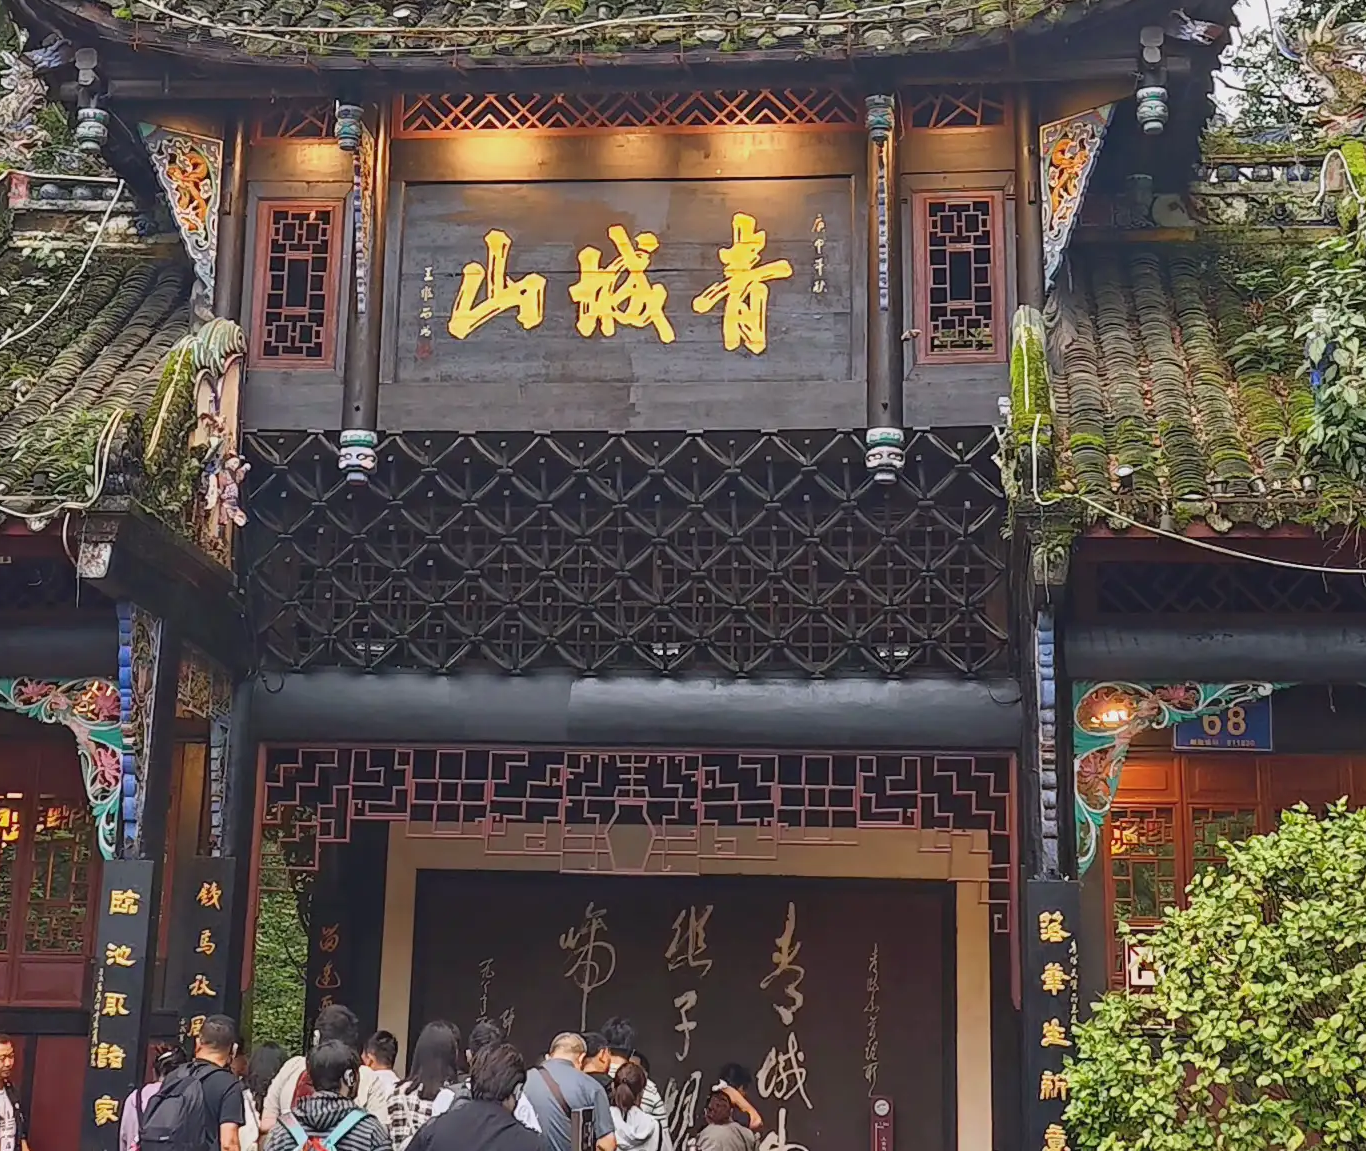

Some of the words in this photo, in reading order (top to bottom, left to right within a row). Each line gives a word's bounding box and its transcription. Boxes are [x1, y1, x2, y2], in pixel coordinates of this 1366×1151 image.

[447, 211, 793, 355] 青城山
[1202, 705, 1247, 736] 68
